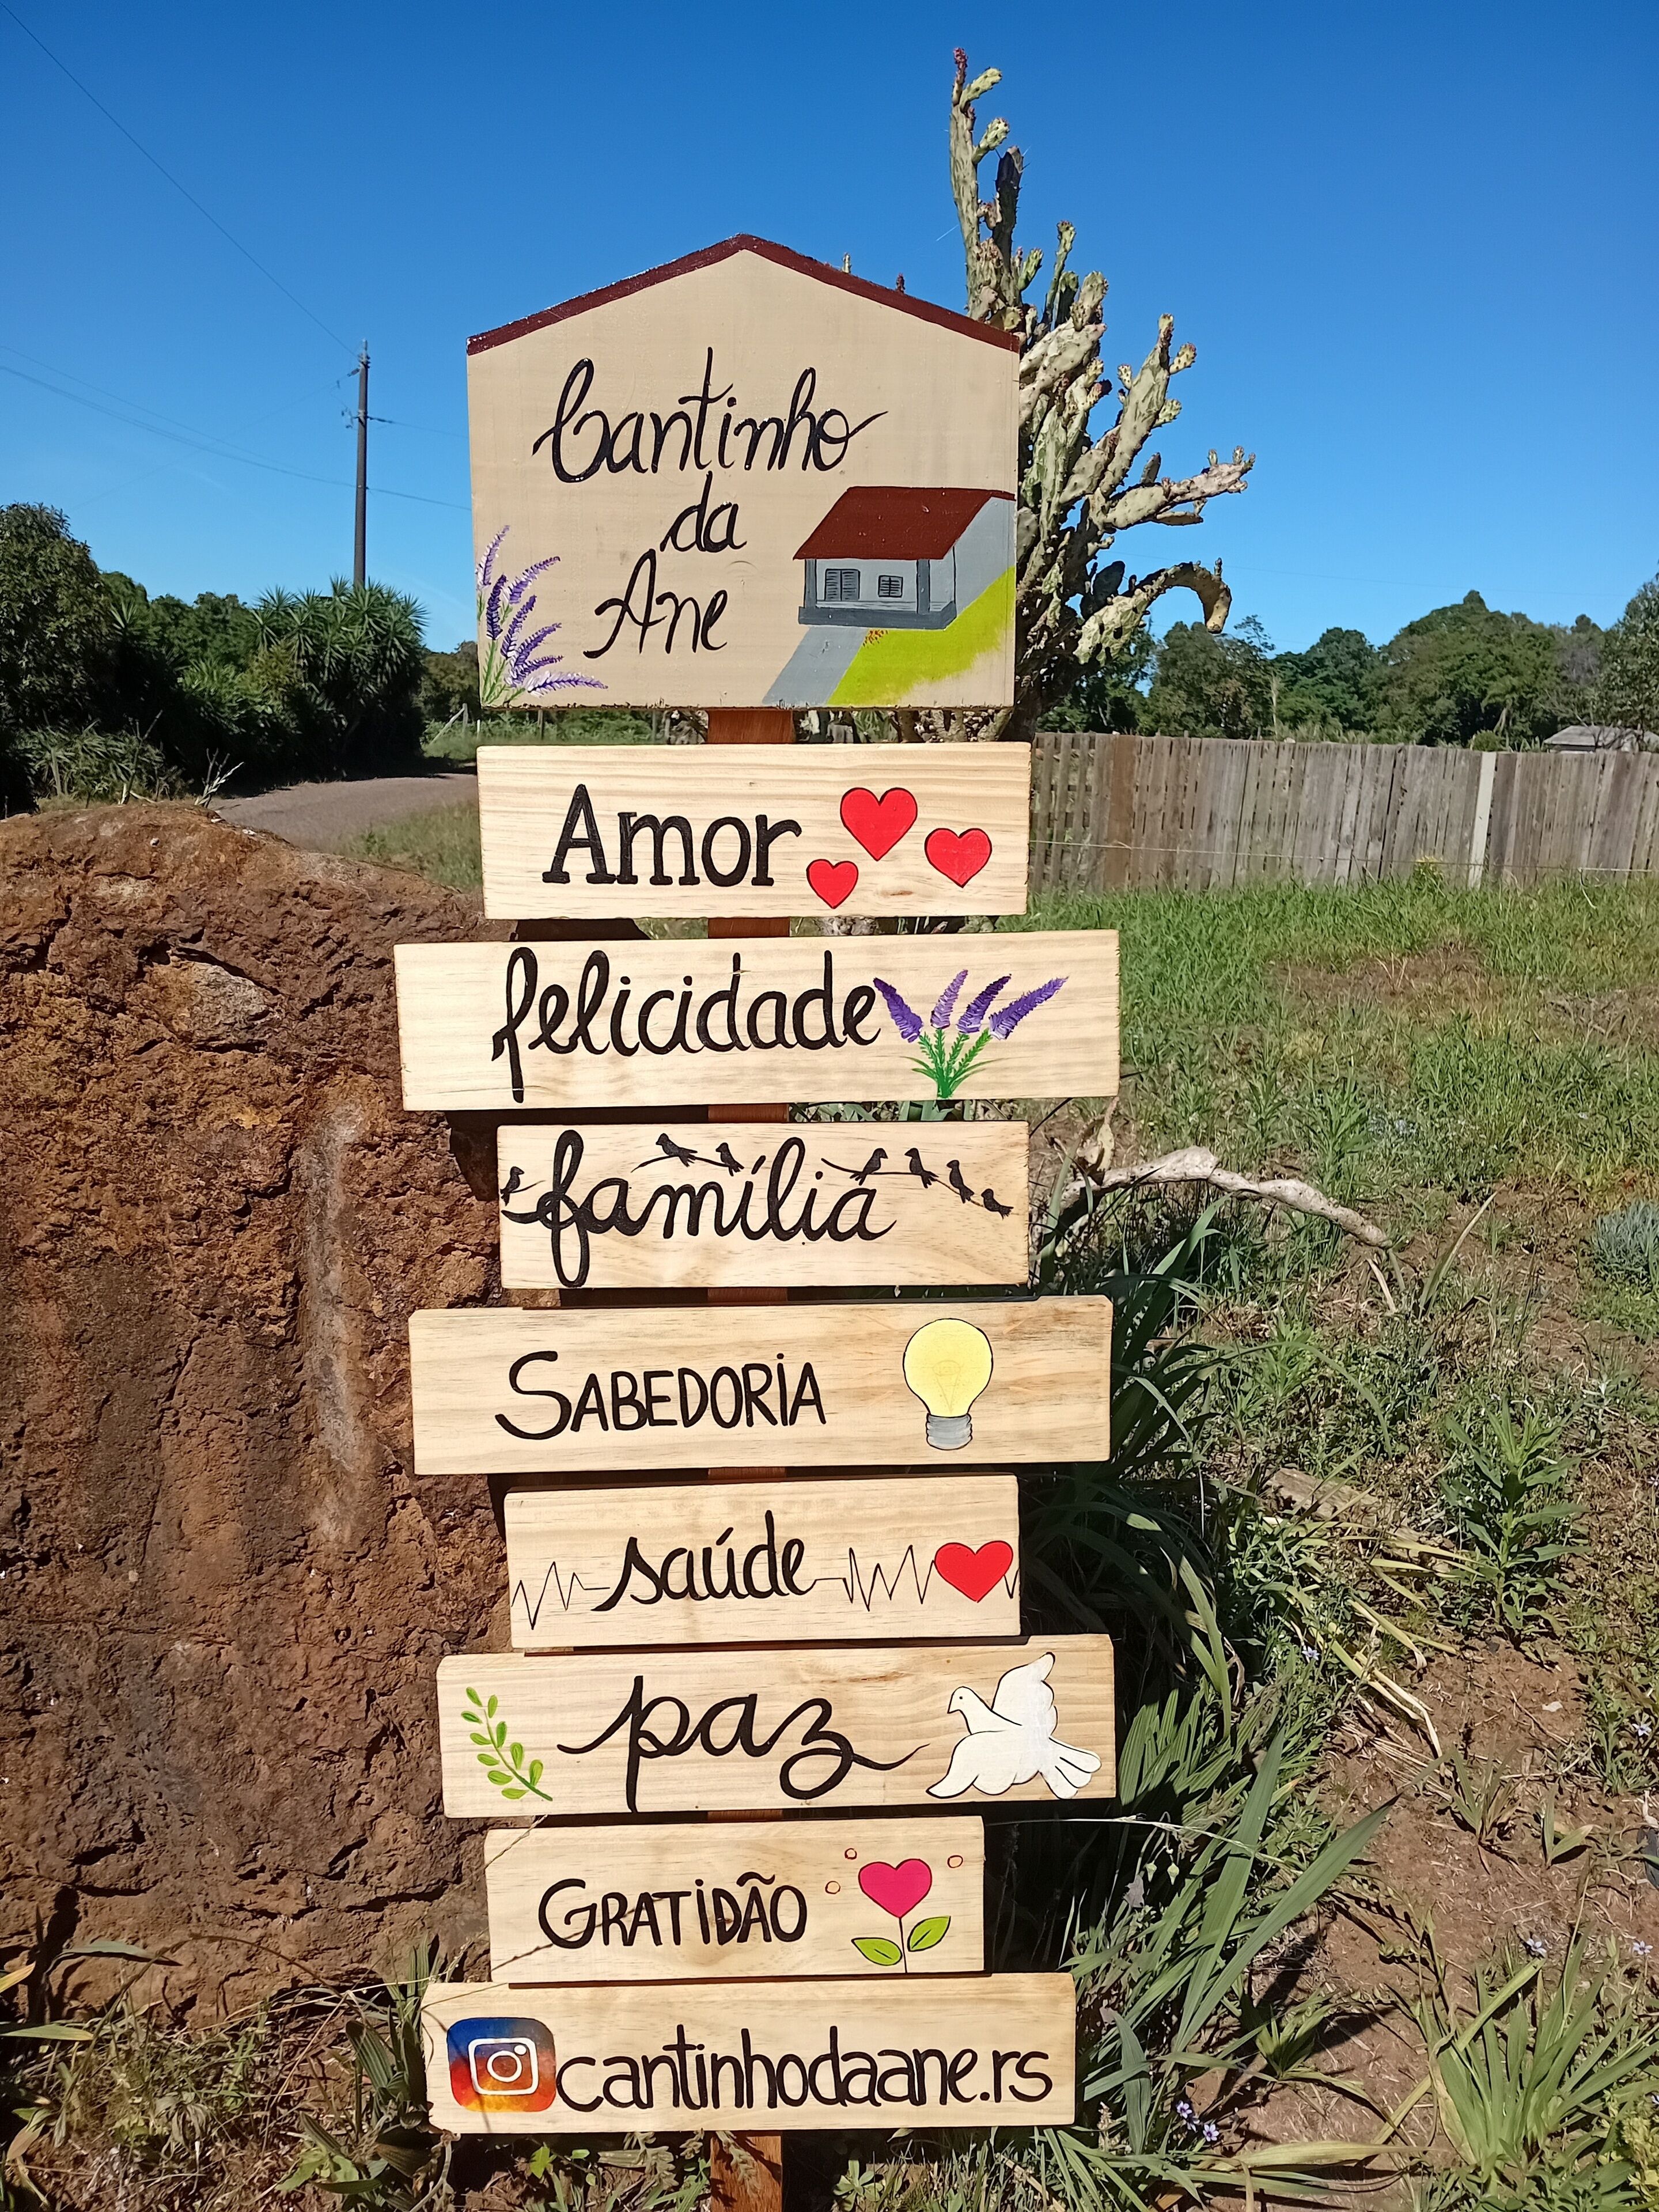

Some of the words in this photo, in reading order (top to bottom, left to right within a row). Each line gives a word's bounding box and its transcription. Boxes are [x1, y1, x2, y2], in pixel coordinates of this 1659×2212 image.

[533, 347, 888, 483] Cantinho
[660, 471, 747, 552] da
[583, 548, 728, 659] Ane
[542, 784, 802, 887] Amor
[491, 946, 881, 1104] felicidade
[501, 1129, 897, 1288] família
[495, 1350, 827, 1440] SABEDORIA
[591, 1510, 816, 1612] saúde
[557, 1675, 930, 1812] paz
[538, 1871, 807, 1949] GRATIDÃO
[556, 2024, 1054, 2112] cantinhodaane.rs
